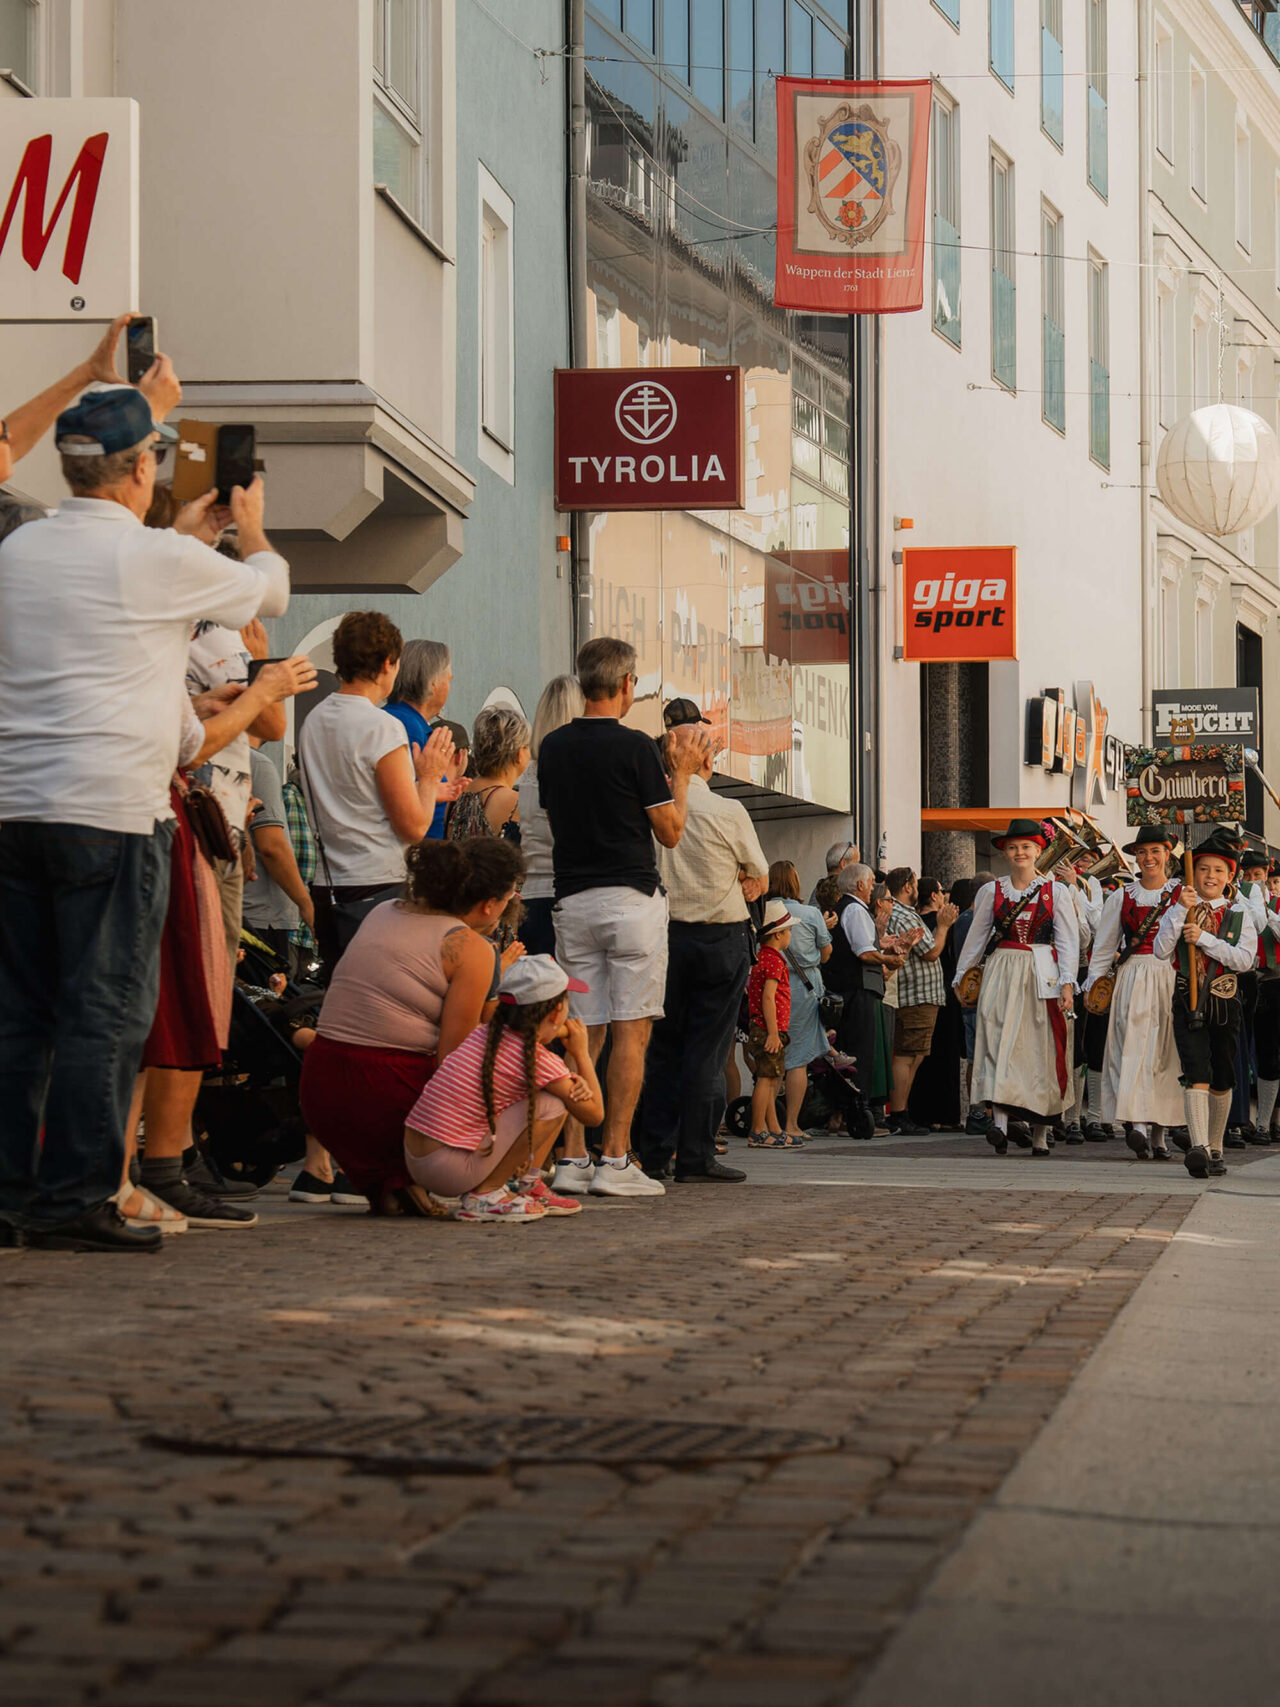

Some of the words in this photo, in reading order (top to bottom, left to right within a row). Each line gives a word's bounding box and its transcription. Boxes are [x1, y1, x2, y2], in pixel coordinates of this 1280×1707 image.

[785, 264, 831, 279] Wappen
[833, 267, 853, 279] der
[854, 268, 884, 279] Stadt
[887, 267, 915, 279] Lienz
[843, 284, 858, 292] 1761
[568, 454, 726, 483] TYROLIA
[912, 572, 1007, 609] giga
[914, 606, 1005, 632] sport
[1139, 764, 1230, 807] Gaimberg
